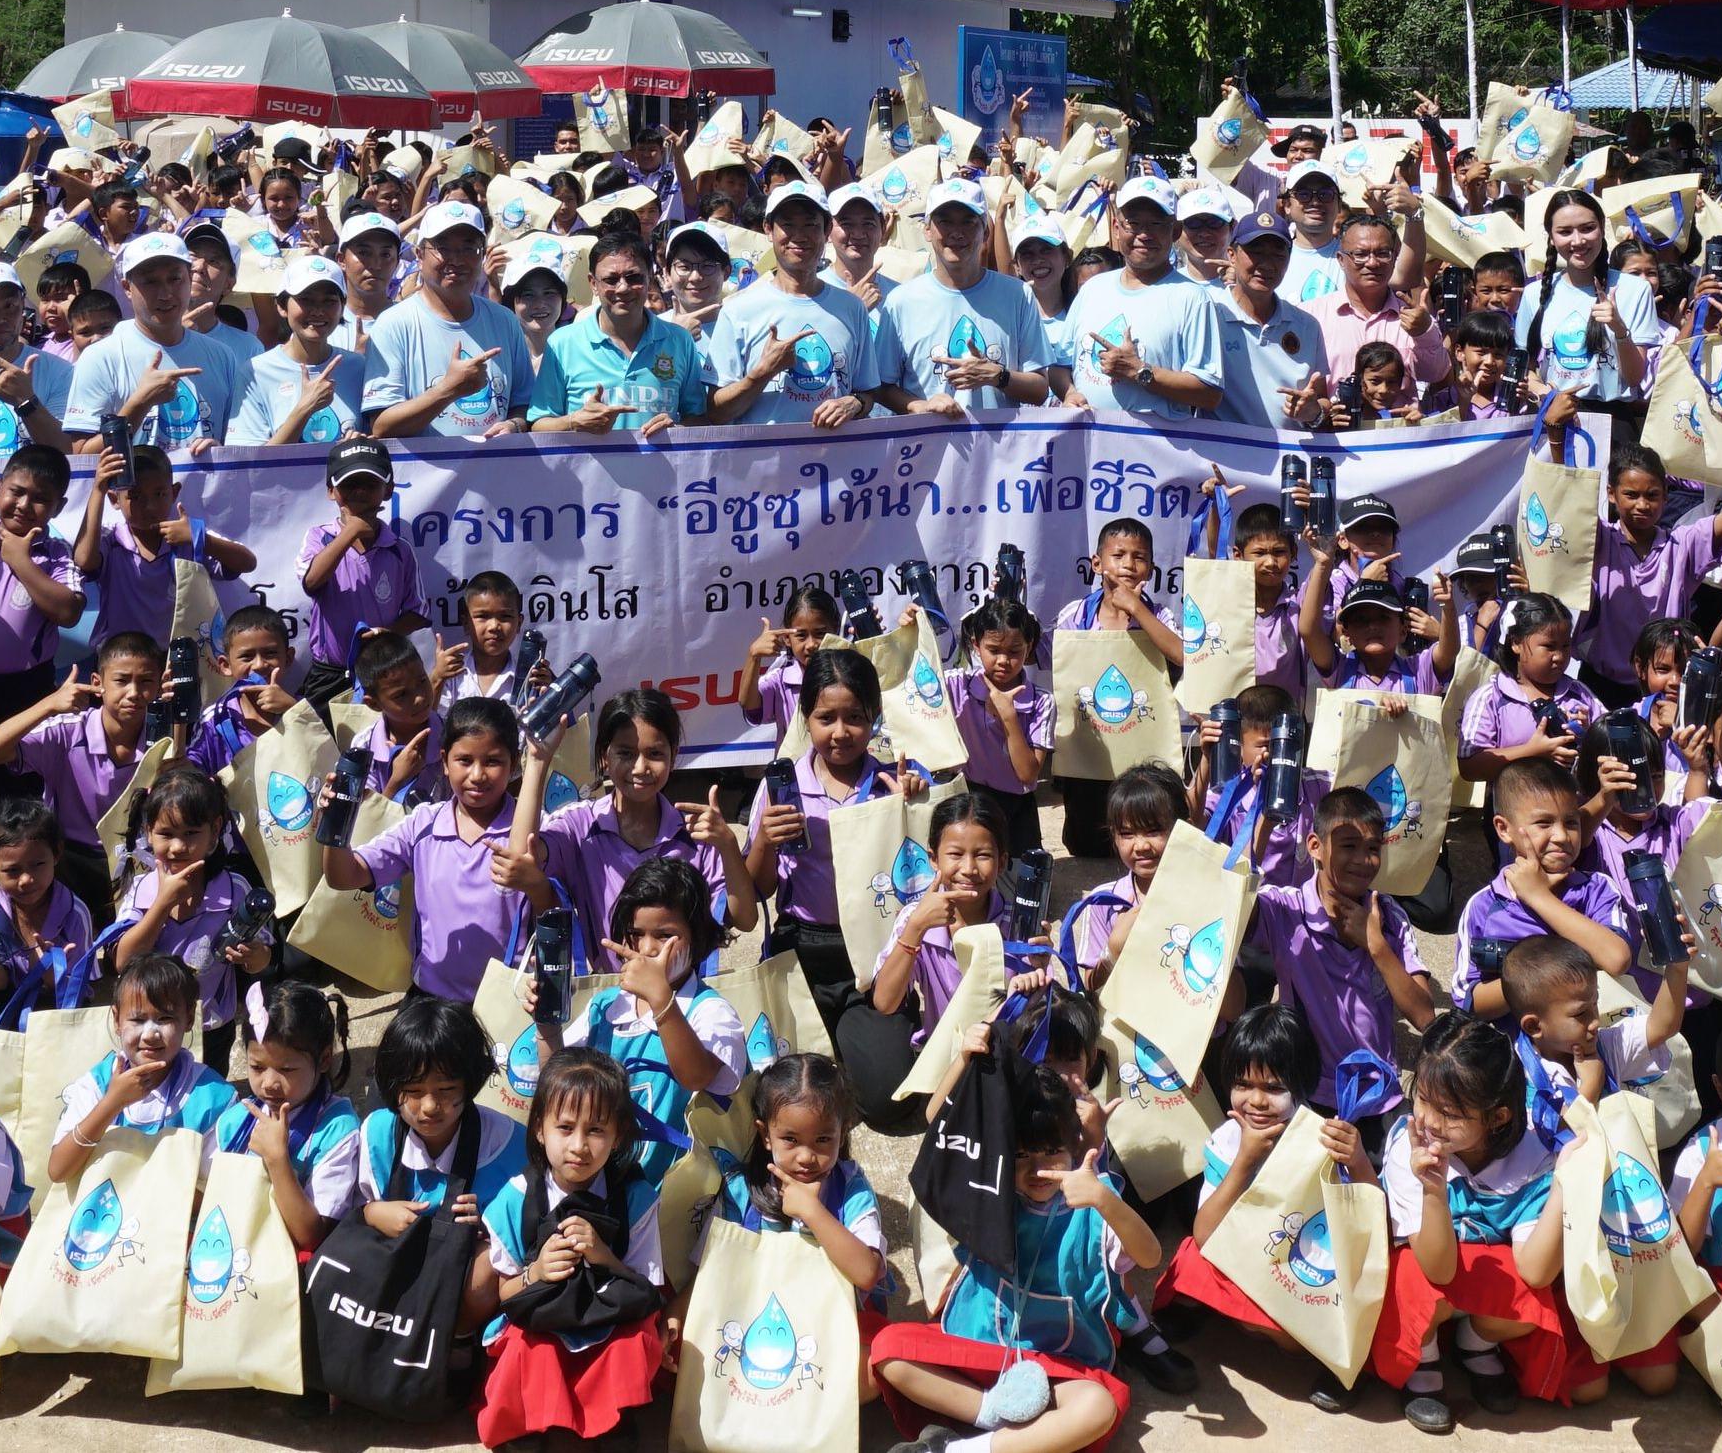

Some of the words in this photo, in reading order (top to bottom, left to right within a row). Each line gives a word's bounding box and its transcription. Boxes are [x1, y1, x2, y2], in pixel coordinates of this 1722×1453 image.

[545, 48, 615, 62] ISUZU
[696, 50, 752, 64] ISUZU
[166, 64, 245, 78] ISUZU
[476, 71, 521, 84] ISUZU
[344, 75, 410, 94] ISUZU
[267, 100, 321, 117] ISUZU
[1560, 357, 1589, 365] ISUZU
[799, 377, 826, 386] ISUZU
[458, 402, 489, 410] ISUZU
[340, 445, 378, 458] ISUZU
[1099, 711, 1128, 720] ISUZU
[1271, 759, 1298, 768] ISUZU
[288, 809, 313, 828] ISUZU
[1015, 897, 1041, 908] ISUZU
[70, 1251, 106, 1264] ISUZU
[1291, 1256, 1324, 1283] ISUZU
[194, 1284, 222, 1295] ISUZU
[328, 1291, 415, 1337] ISUZU
[747, 1368, 787, 1383] ISUZU
